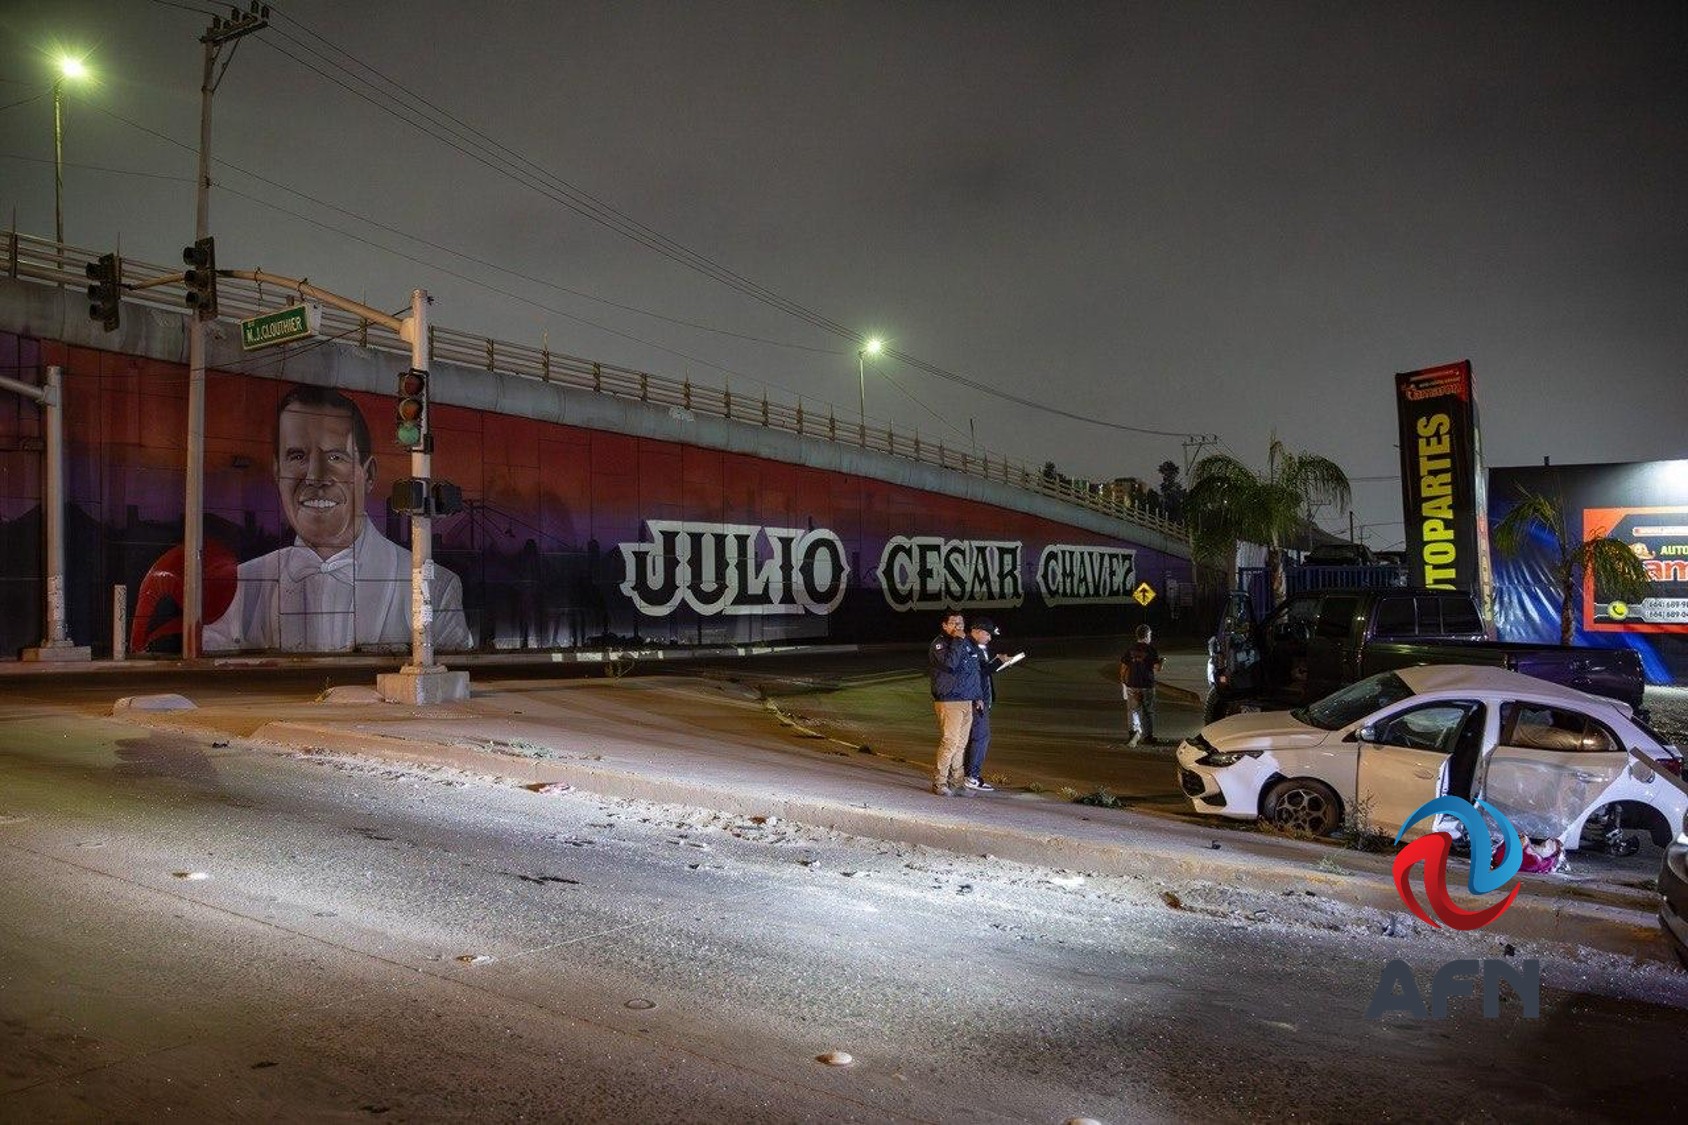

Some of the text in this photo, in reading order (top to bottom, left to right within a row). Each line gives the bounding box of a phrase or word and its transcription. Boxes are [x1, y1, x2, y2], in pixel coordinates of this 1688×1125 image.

[618, 519, 1137, 617] JULIO CESAR CHAVEZ
[1417, 412, 1457, 590] TOPARTES
